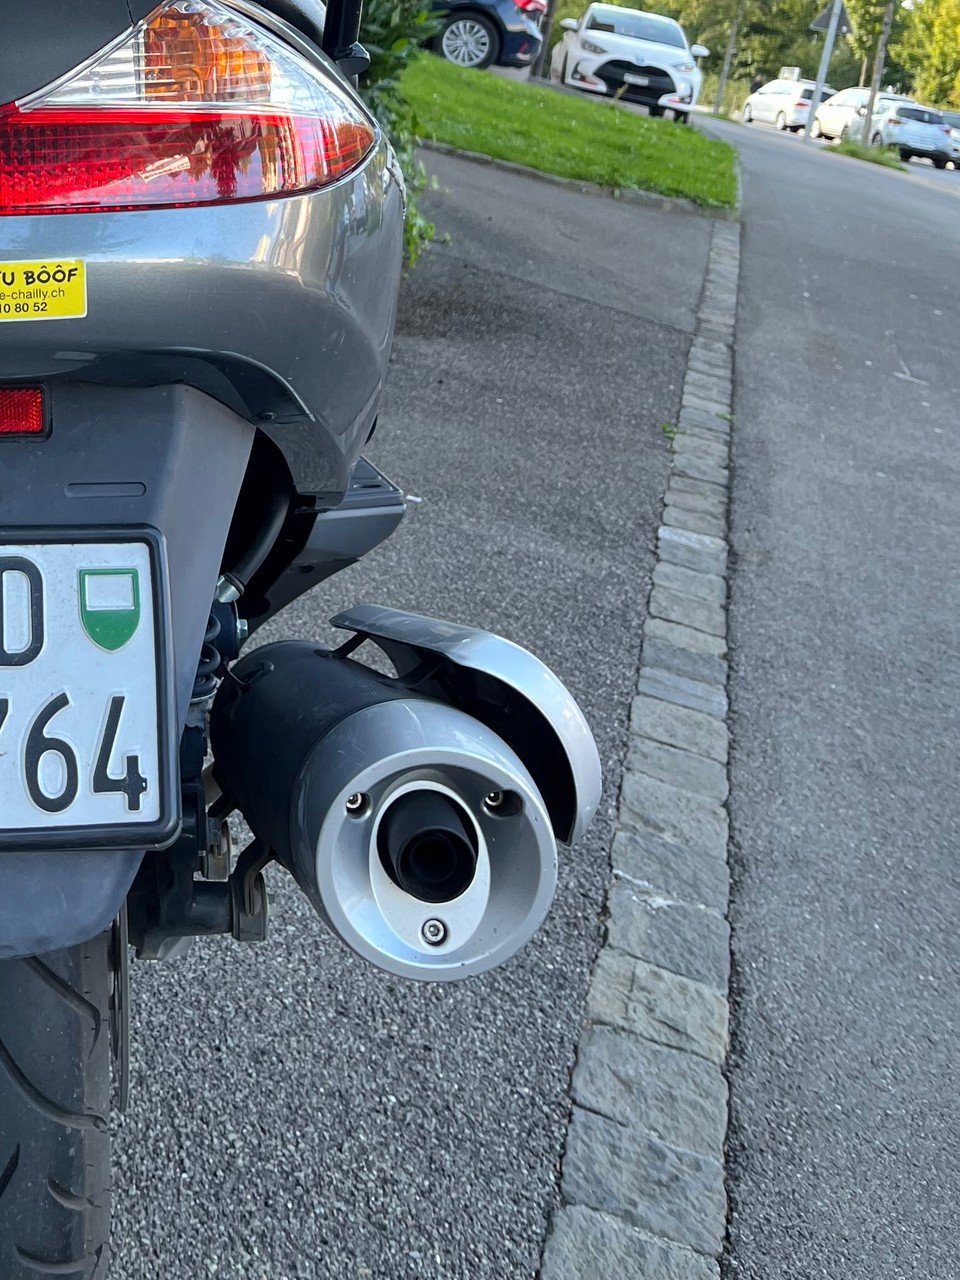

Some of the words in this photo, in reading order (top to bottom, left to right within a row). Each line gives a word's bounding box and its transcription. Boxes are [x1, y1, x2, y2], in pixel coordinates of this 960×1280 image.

[23, 264, 78, 286] BÔÔF
[14, 303, 30, 313] 80
[32, 301, 48, 312] 52
